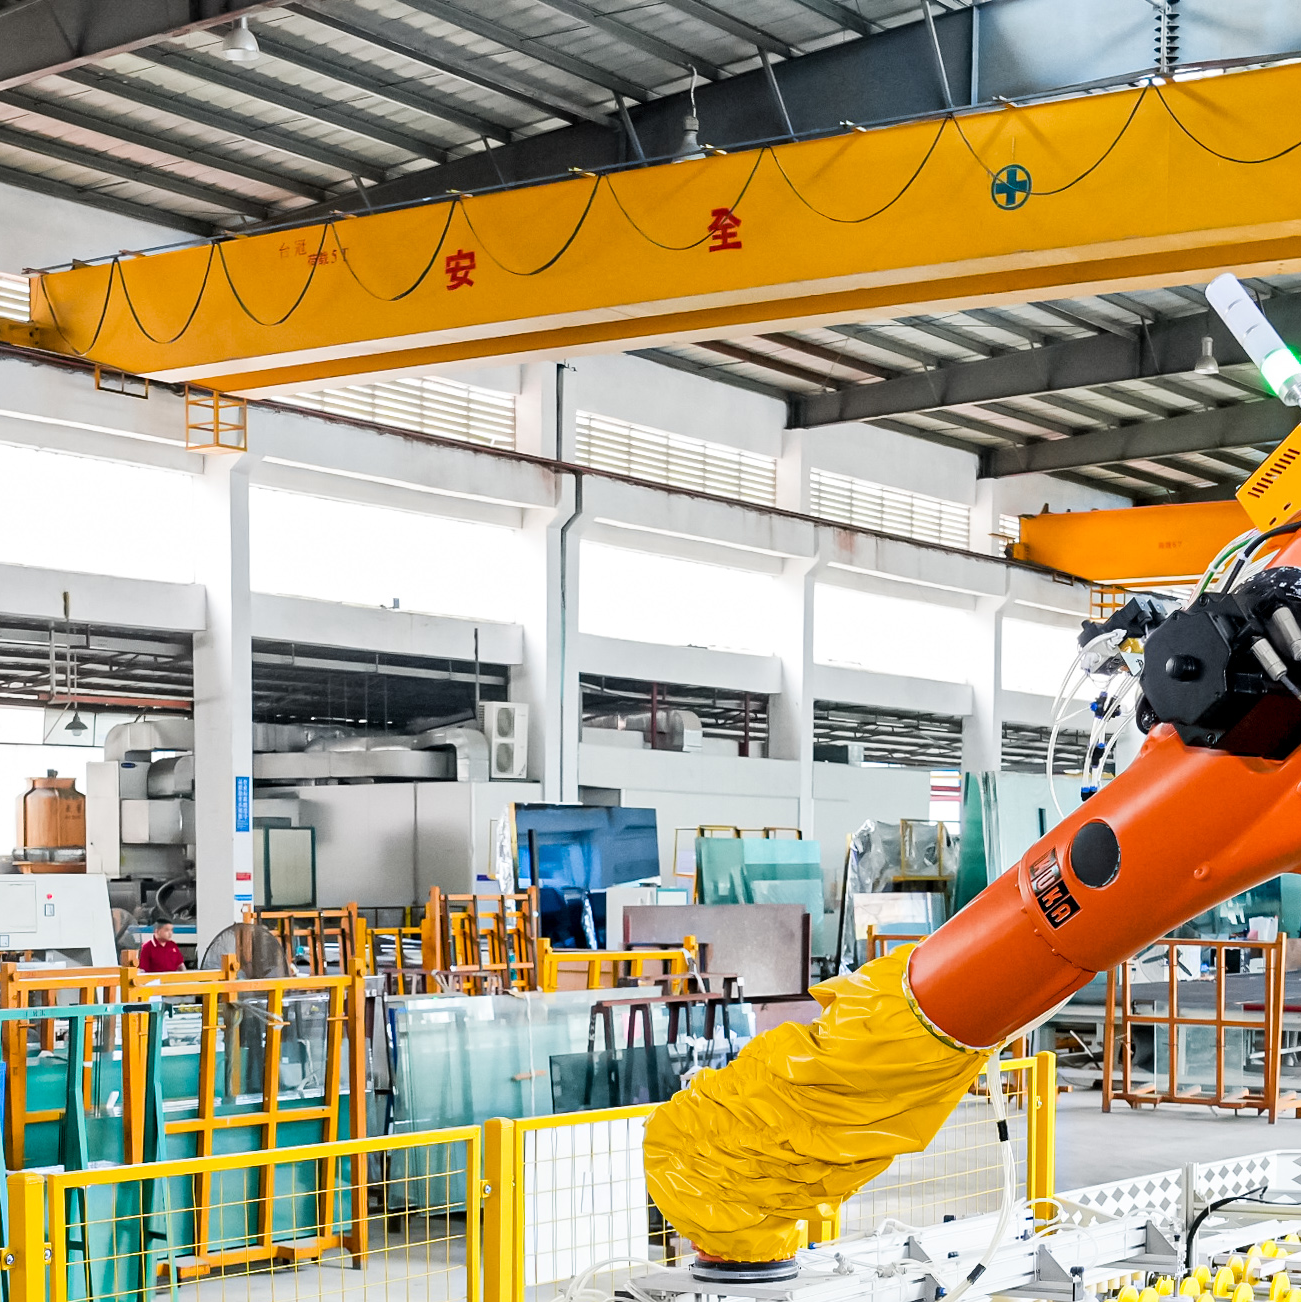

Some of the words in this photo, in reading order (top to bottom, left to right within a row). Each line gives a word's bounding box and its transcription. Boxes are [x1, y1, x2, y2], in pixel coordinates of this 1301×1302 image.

[445, 249, 476, 291] 安
[708, 207, 742, 252] 全
[1030, 849, 1076, 926] KUKA
